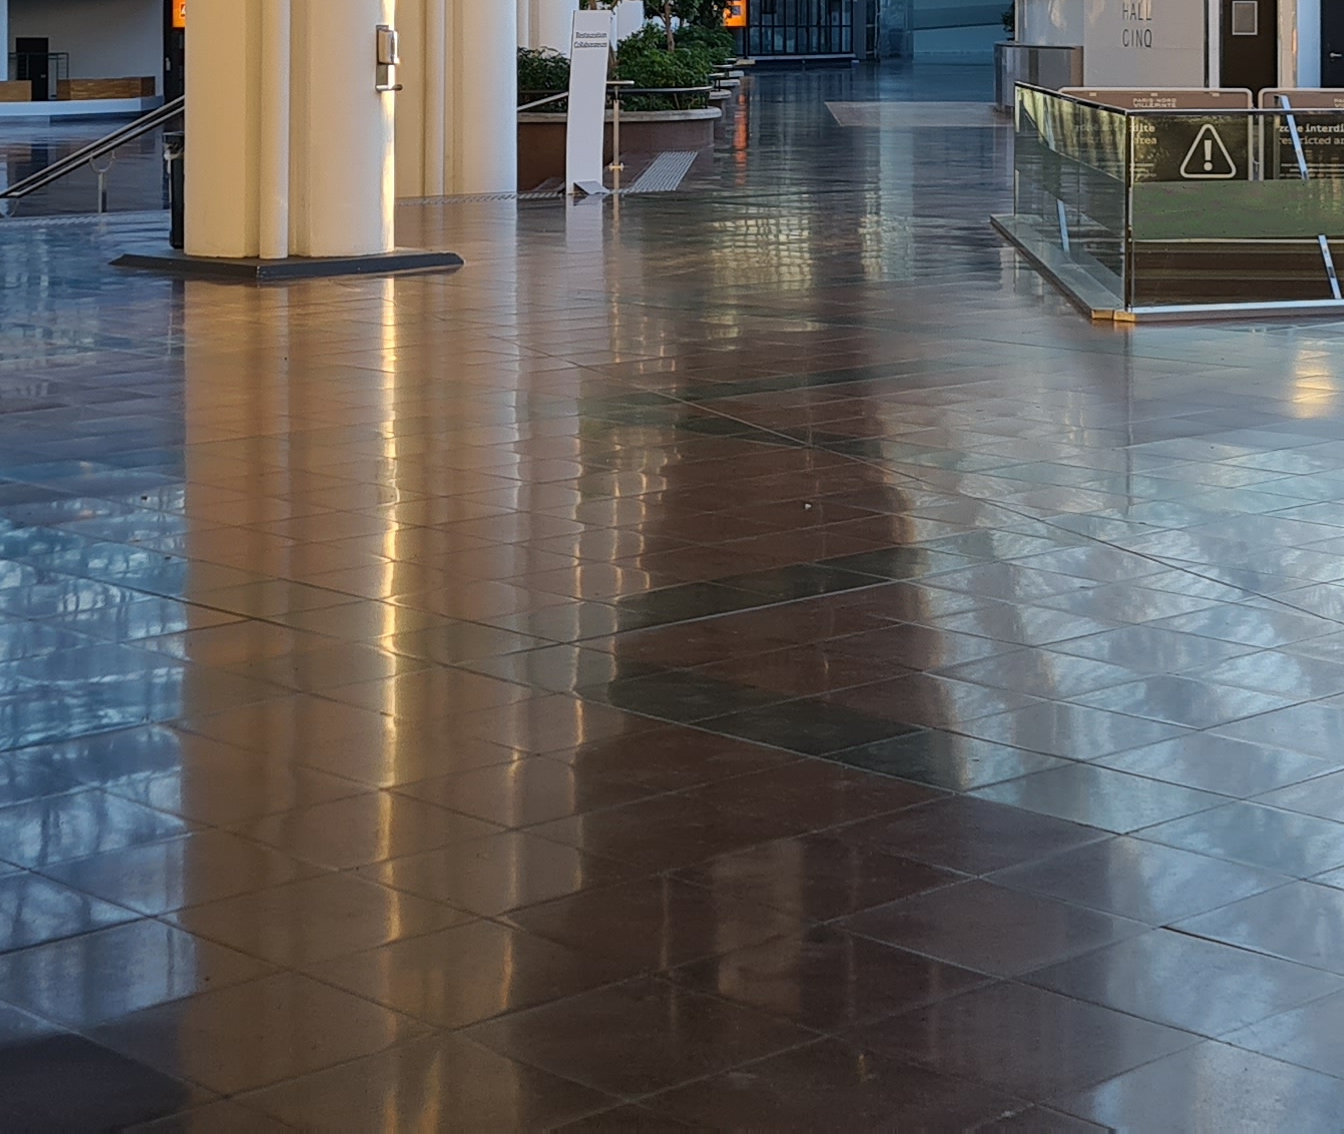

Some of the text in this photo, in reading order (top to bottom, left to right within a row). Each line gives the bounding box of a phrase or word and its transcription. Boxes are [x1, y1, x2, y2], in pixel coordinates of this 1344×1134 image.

[1122, 2, 1152, 21] HALL
[1122, 28, 1153, 48] CINQ
[1279, 125, 1304, 133] zoe
